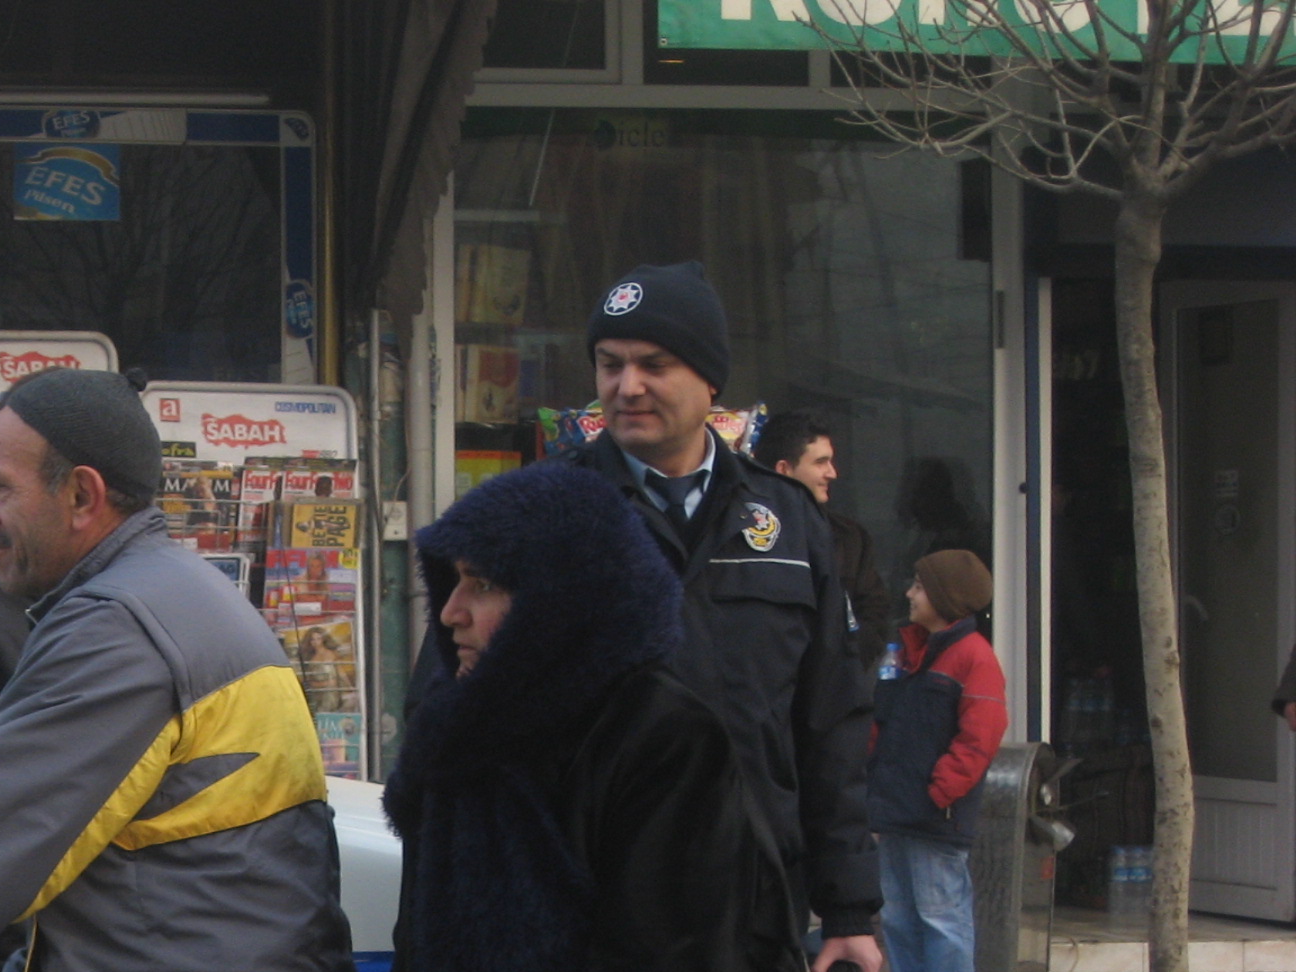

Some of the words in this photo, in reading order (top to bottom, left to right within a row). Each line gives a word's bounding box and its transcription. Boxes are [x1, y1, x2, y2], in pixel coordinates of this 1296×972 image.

[52, 109, 91, 130] EFES
[25, 166, 106, 205] EFES
[275, 402, 336, 414] COSMOPOLITAN
[206, 420, 282, 442] SABAH
